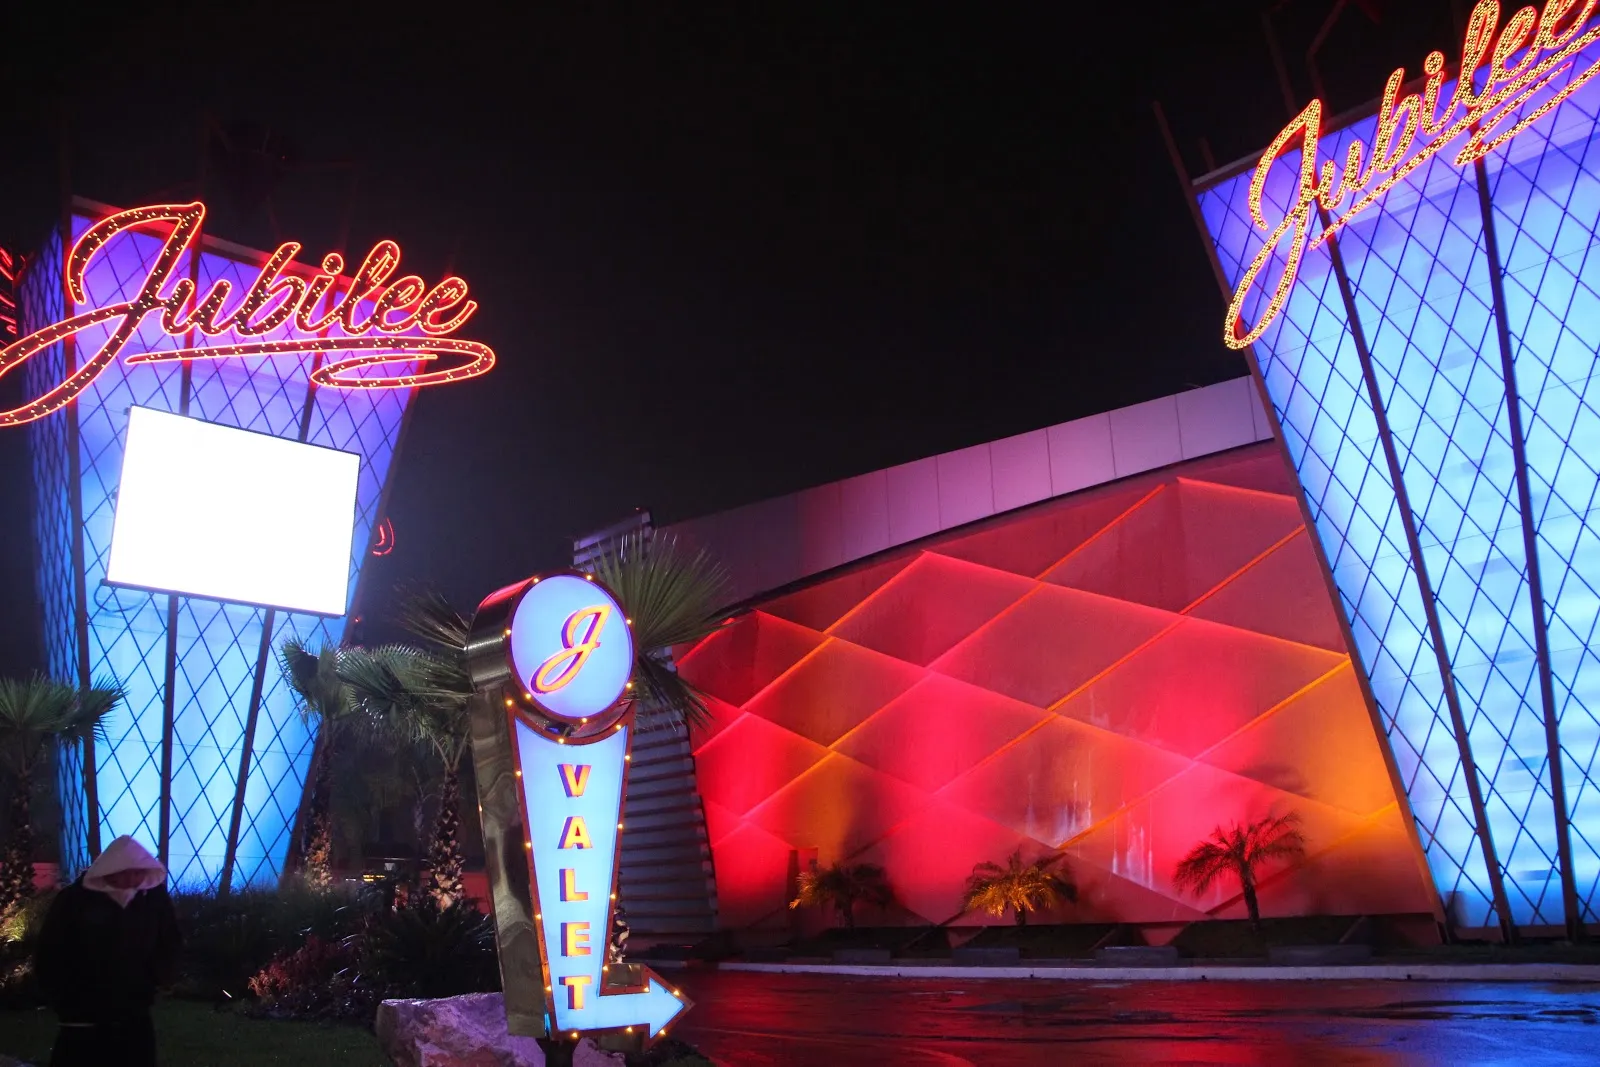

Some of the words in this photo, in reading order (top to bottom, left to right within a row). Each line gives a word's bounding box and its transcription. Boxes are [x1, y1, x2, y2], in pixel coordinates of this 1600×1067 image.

[1224, 0, 1597, 349] Jubilee
[0, 201, 478, 426] Jubilee
[530, 604, 612, 694] J
[557, 763, 593, 1010] VALET
